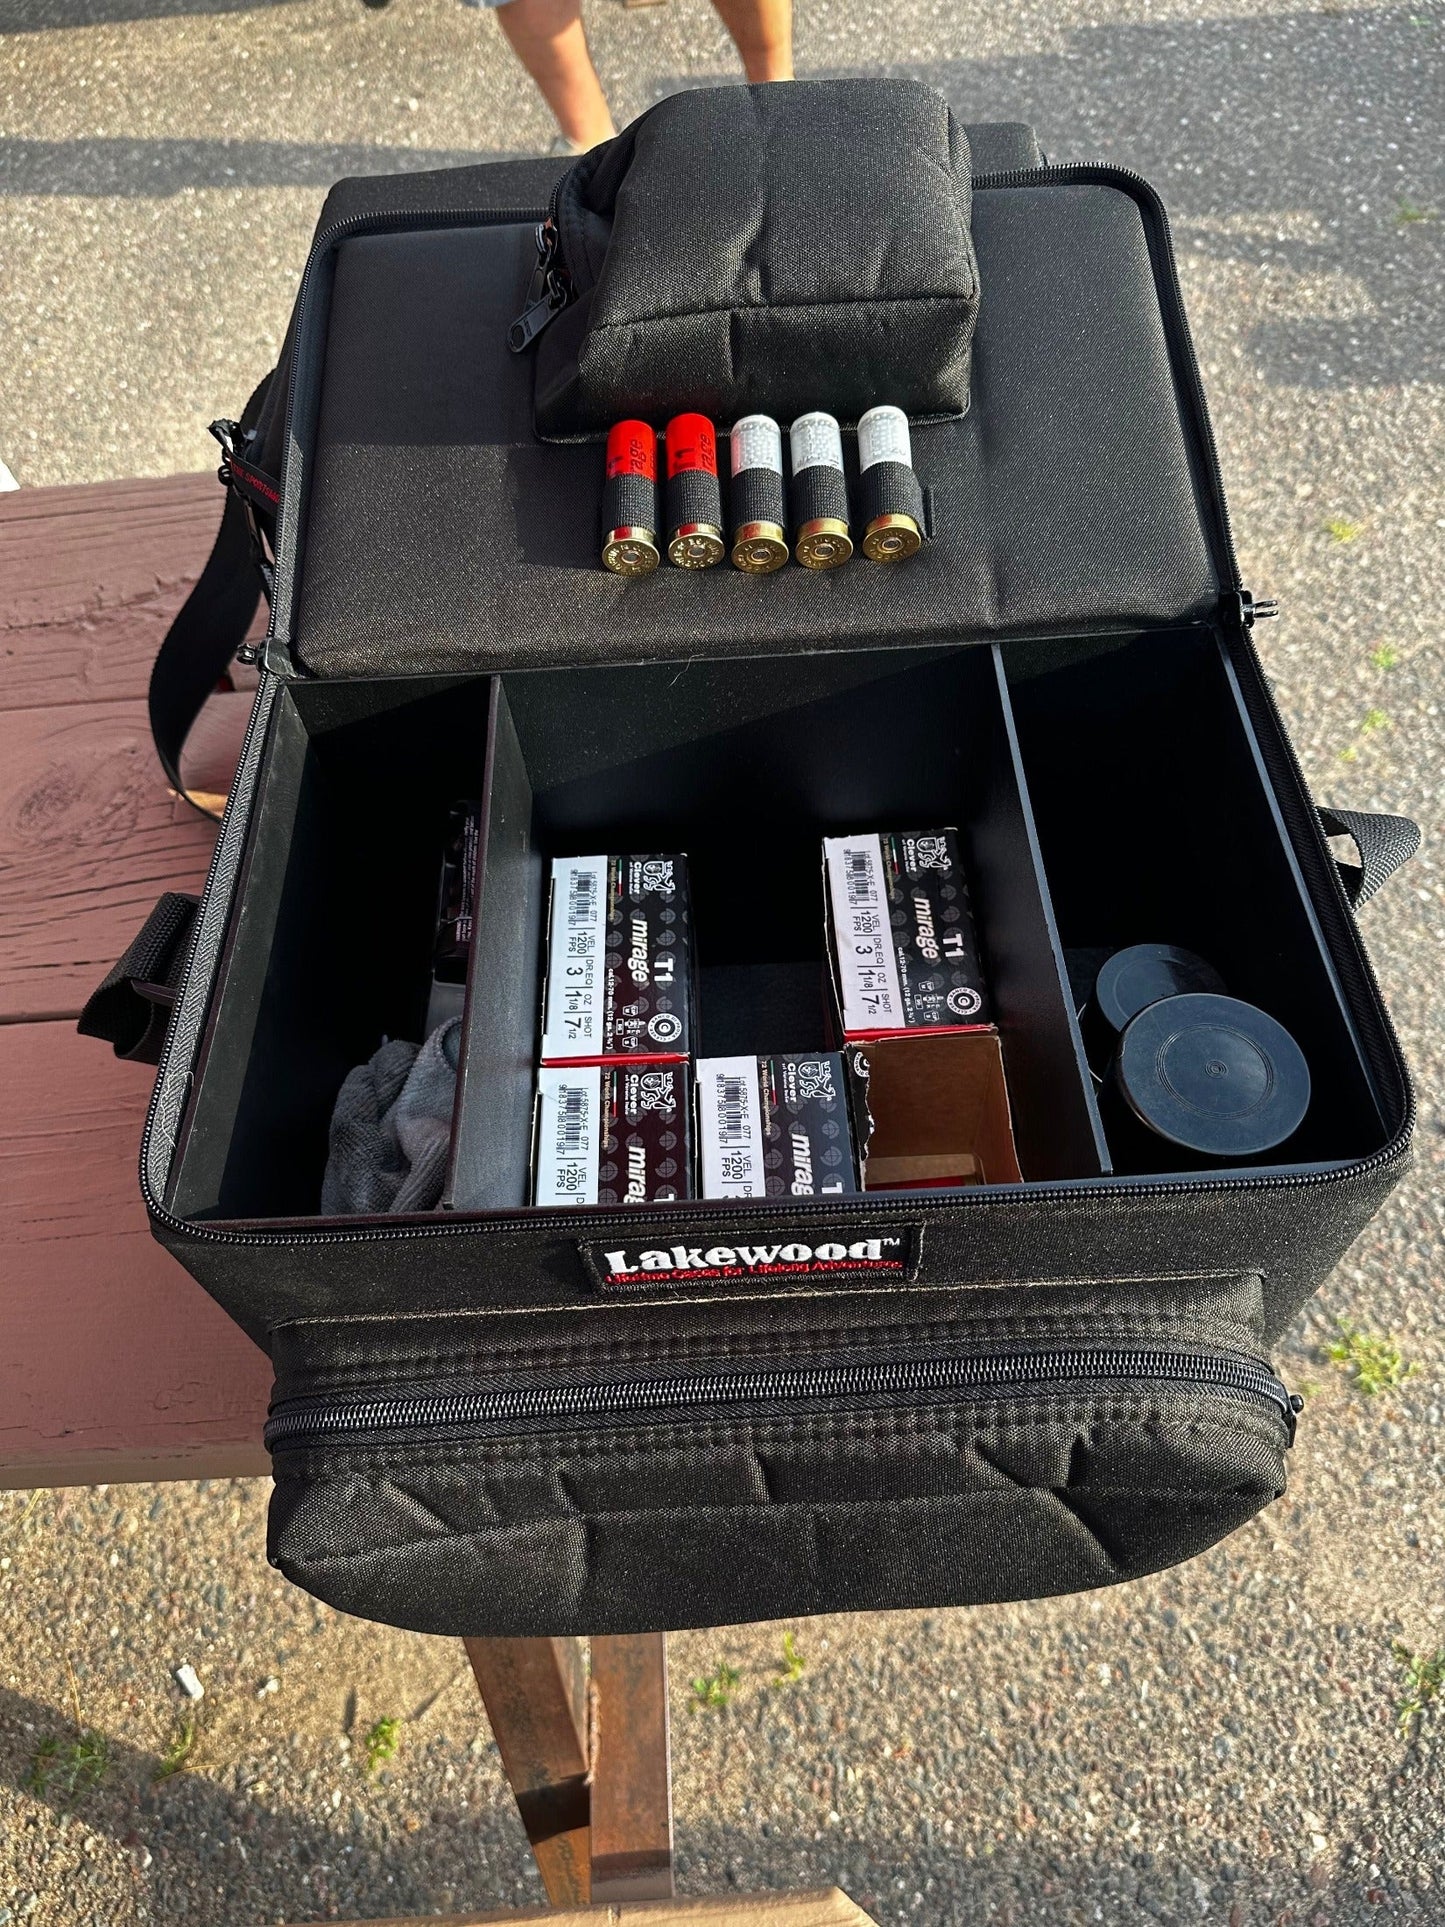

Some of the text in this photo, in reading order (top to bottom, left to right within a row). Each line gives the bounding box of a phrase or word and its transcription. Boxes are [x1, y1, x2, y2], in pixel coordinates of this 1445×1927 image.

[907, 839, 916, 872] Clever
[633, 862, 642, 894] Clever
[853, 916, 862, 931] FPS
[861, 911, 873, 933] 1200
[913, 897, 939, 959] mirage
[577, 931, 587, 954] 1200
[628, 919, 650, 982] mirage
[855, 945, 872, 954] 3
[942, 934, 964, 957] T1
[566, 967, 583, 975] 3
[653, 958, 673, 982] T1
[877, 972, 886, 983] OZ
[584, 994, 592, 1005] OZ
[882, 993, 891, 1013] SHOT
[584, 1016, 592, 1037] SHOT
[604, 1072, 610, 1080] 72
[787, 1063, 797, 1102] Clever
[630, 1074, 639, 1114] Clever
[763, 1089, 771, 1135] Championships
[743, 1125, 751, 1139] 077
[722, 1157, 730, 1177] FPS
[731, 1150, 742, 1179] 1200
[557, 1169, 565, 1188] FPS
[566, 1162, 577, 1191] 1200
[604, 1238, 882, 1275] Lakewood
[671, 1268, 721, 1280] Cases
[722, 1265, 743, 1278] for
[811, 1260, 903, 1272] Adventures
